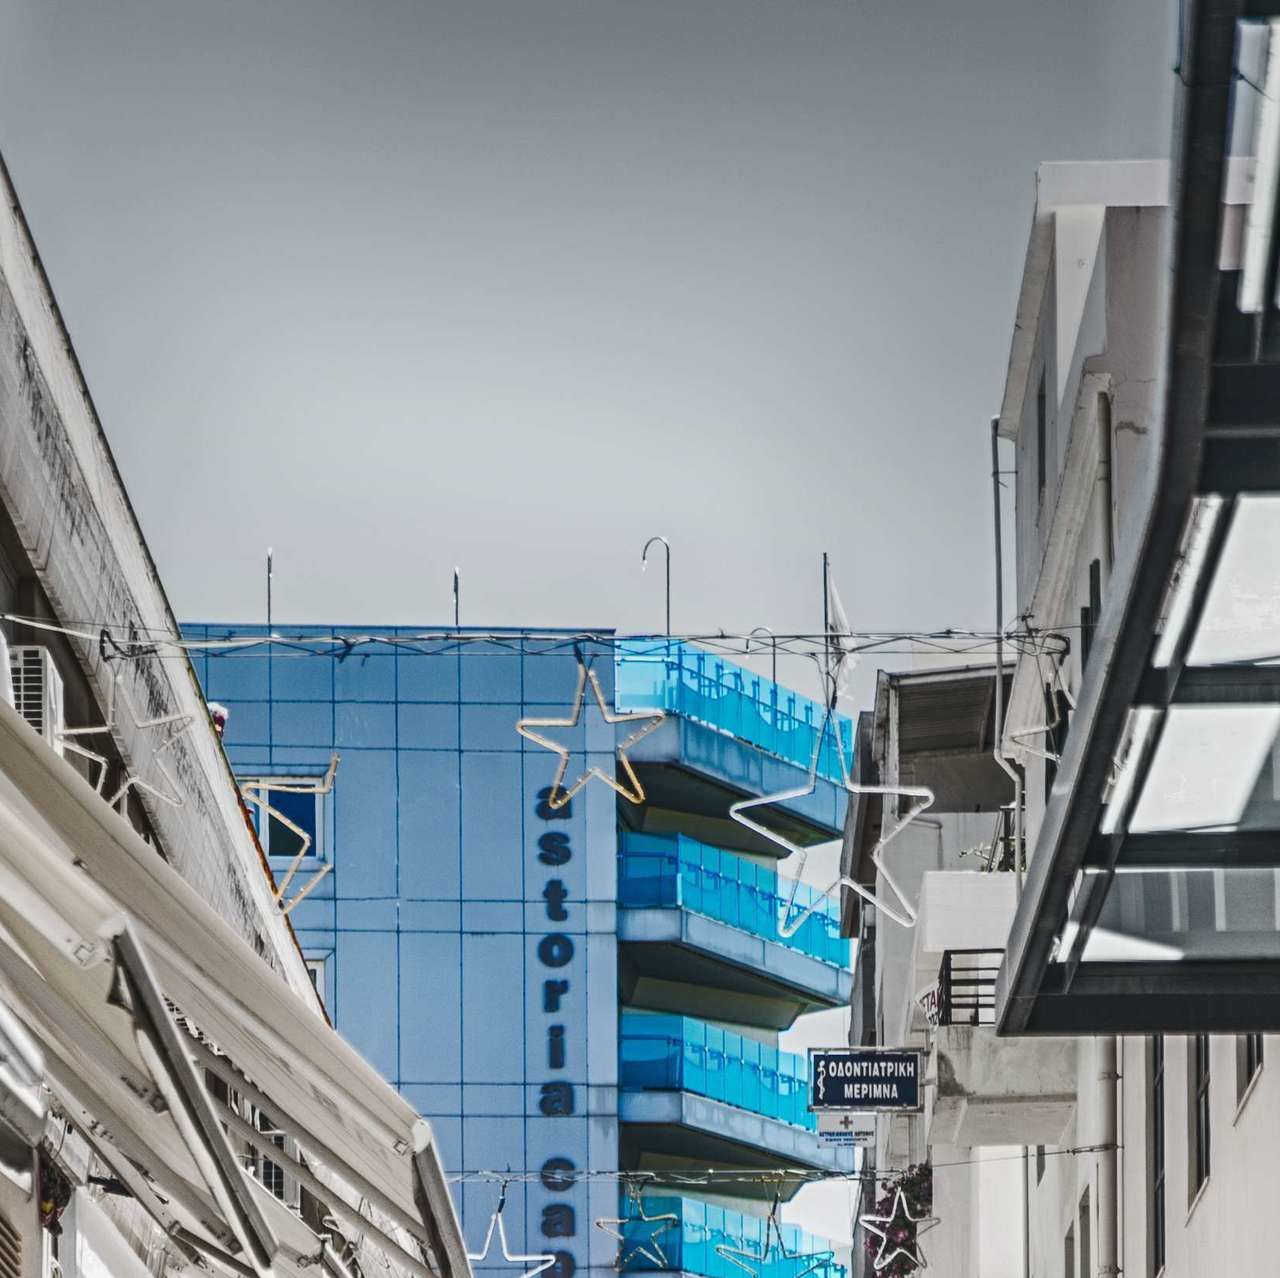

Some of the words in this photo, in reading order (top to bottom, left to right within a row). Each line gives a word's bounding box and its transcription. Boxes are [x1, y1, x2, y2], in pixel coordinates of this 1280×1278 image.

[534, 785, 575, 1117] astoria
[828, 1061, 915, 1078] ΟΔΟΝΤΙΑΤΡΙΚΗ
[844, 1083, 898, 1099] ΜΕΡΙΜΝΑ
